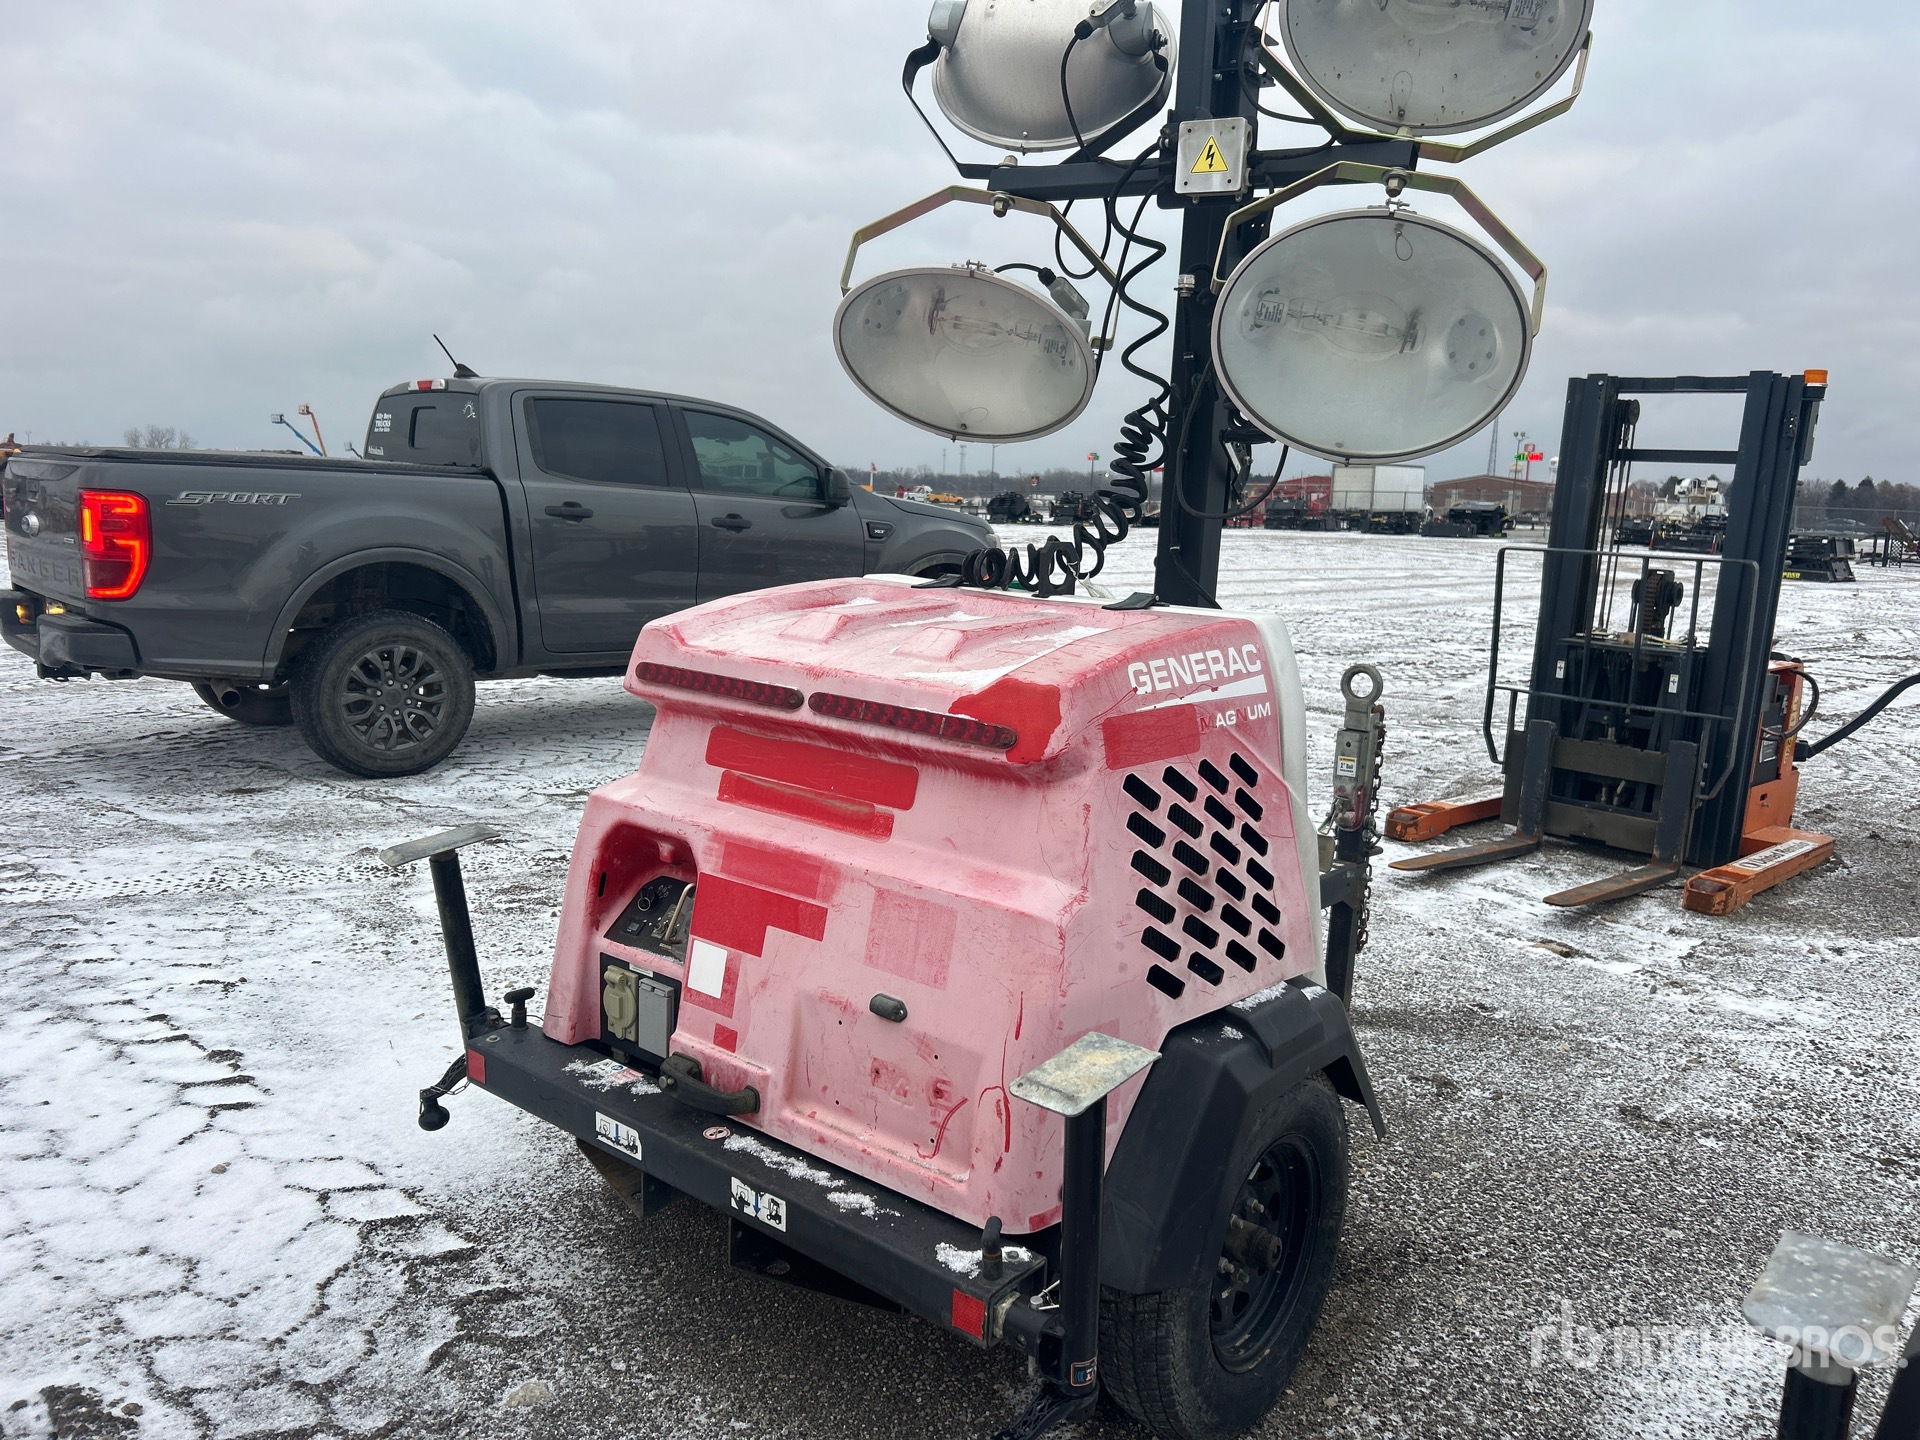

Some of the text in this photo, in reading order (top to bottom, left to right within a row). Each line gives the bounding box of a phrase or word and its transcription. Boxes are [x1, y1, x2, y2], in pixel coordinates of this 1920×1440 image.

[165, 490, 302, 506] SPORT
[10, 550, 81, 588] RANGER
[1127, 643, 1262, 695] GENERAC
